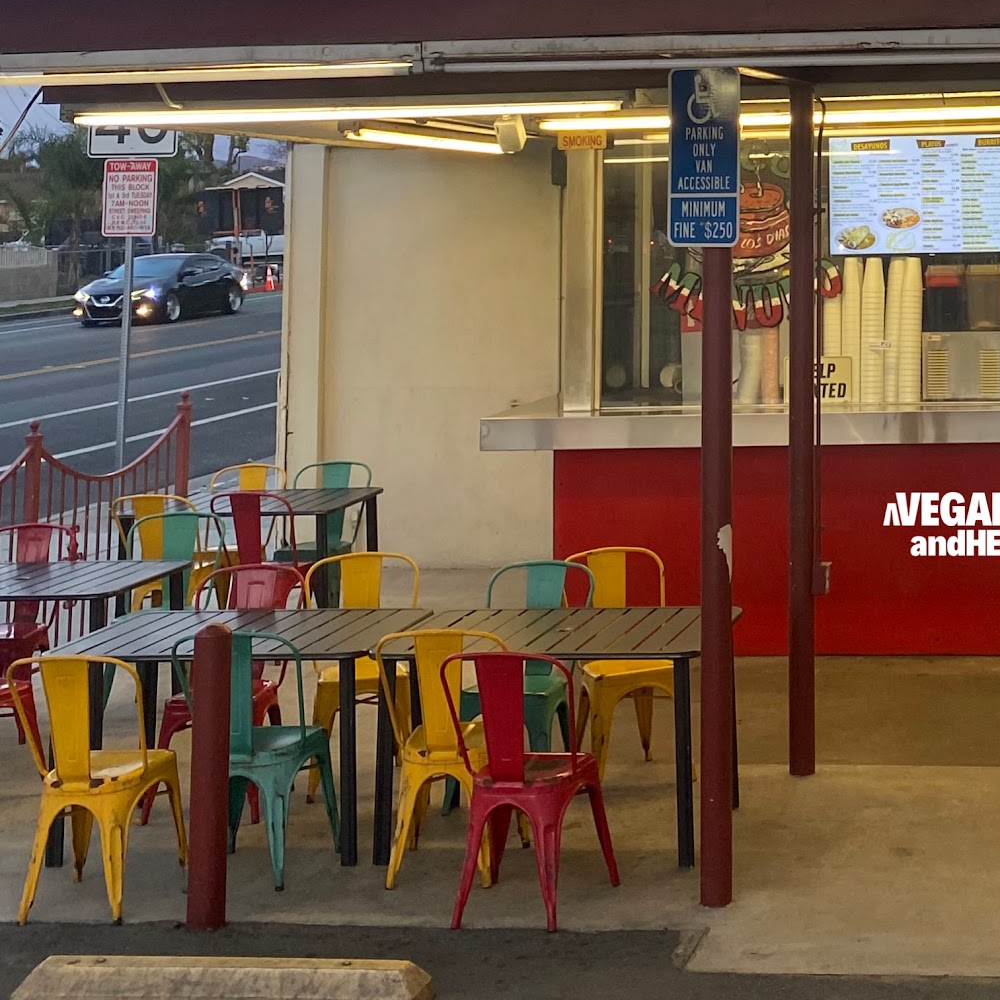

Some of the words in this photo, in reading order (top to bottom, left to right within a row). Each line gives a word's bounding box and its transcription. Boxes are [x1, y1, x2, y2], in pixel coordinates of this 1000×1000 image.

[685, 126, 724, 140] PARKING
[562, 135, 603, 147] SMOKING
[853, 142, 888, 150] DESAYUNOS
[692, 143, 717, 157] ONLY
[110, 162, 151, 171] TOW-AWAY
[695, 159, 713, 174] VAN
[109, 175, 119, 183] NO
[123, 174, 153, 183] PARKING
[677, 176, 731, 190] ACCESSIBLE
[128, 183, 150, 191] BLOCK
[681, 200, 726, 218] MINIMUM
[674, 222, 696, 239] FINE
[703, 220, 733, 240] $250
[740, 237, 763, 249] LOS
